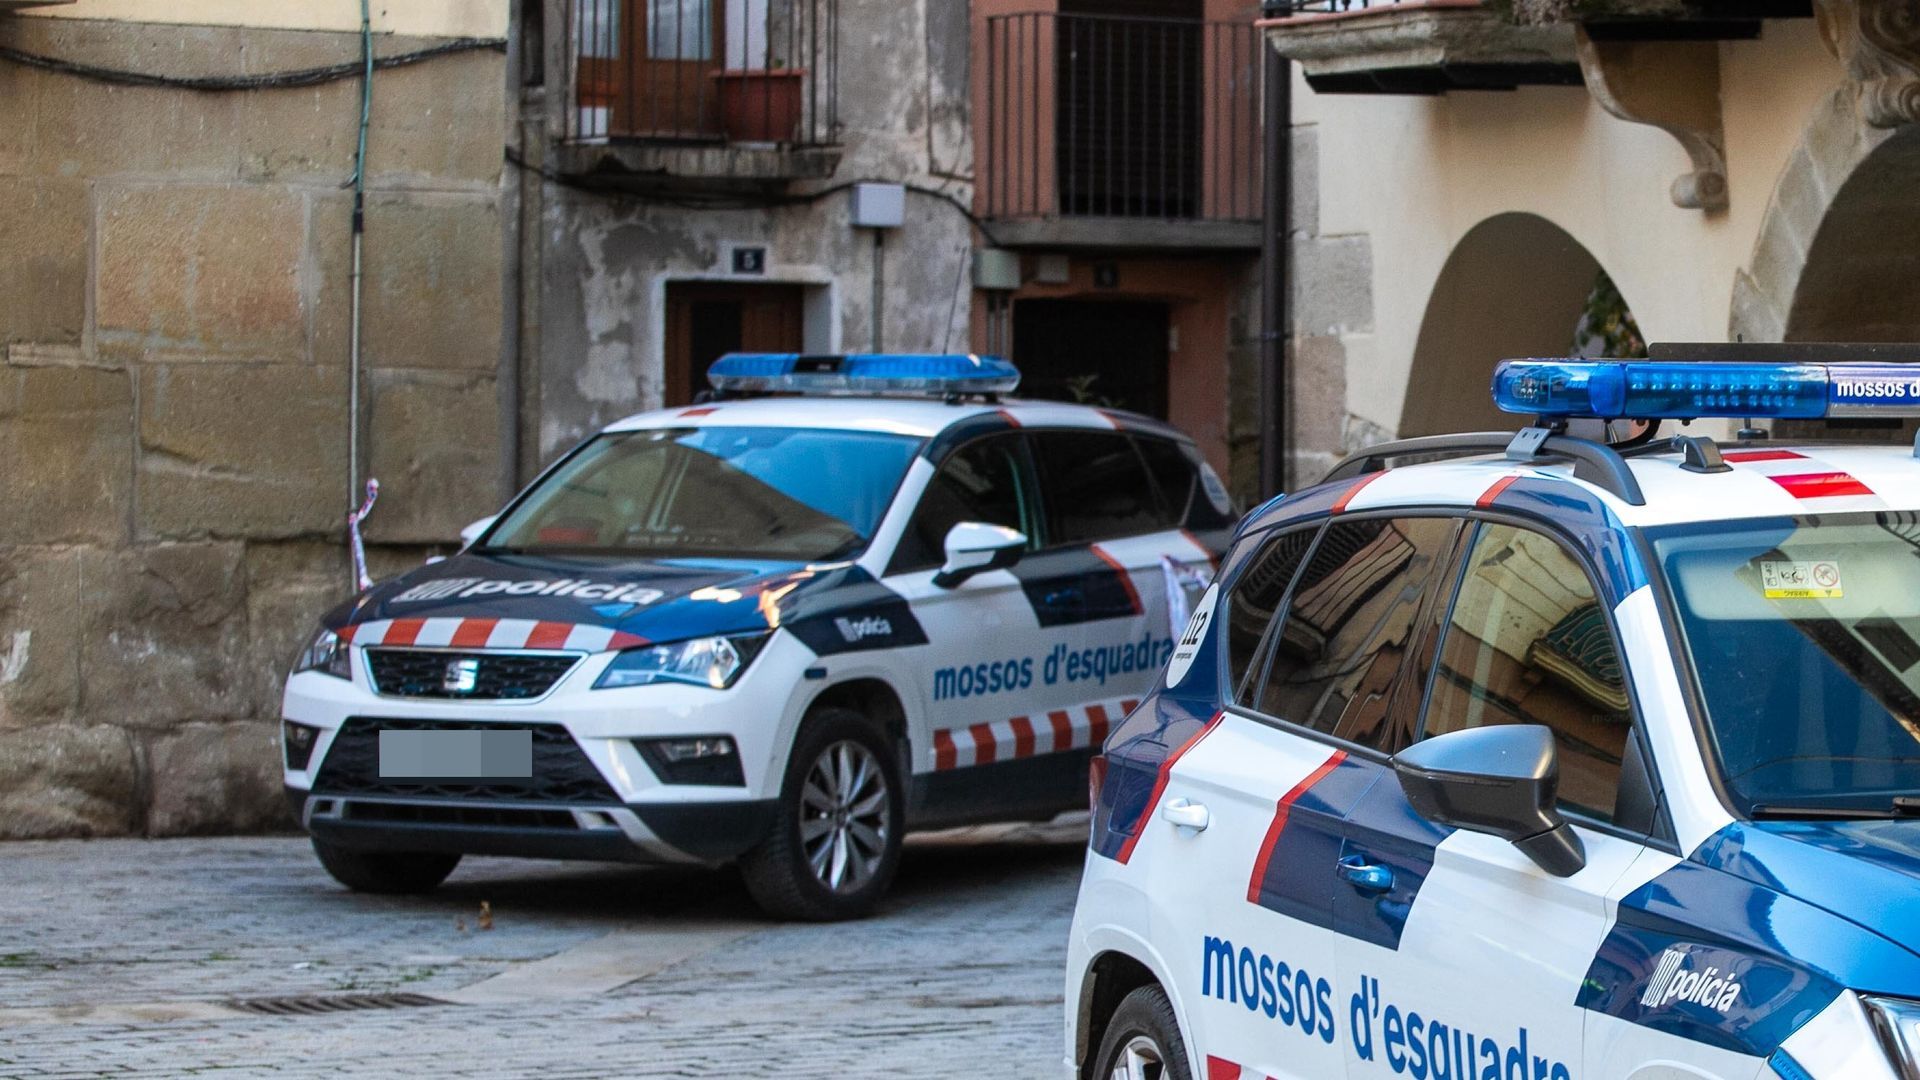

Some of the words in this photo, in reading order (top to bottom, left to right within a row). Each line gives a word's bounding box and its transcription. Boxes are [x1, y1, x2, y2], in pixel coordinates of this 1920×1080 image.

[1836, 380, 1906, 398] mossos
[458, 578, 665, 606] policia
[1181, 611, 1208, 646] 112
[934, 657, 1034, 701] mossos
[1202, 935, 1335, 1044] mossos
[1350, 974, 1571, 1080] d'esquad
[1660, 966, 1741, 1012] policia
